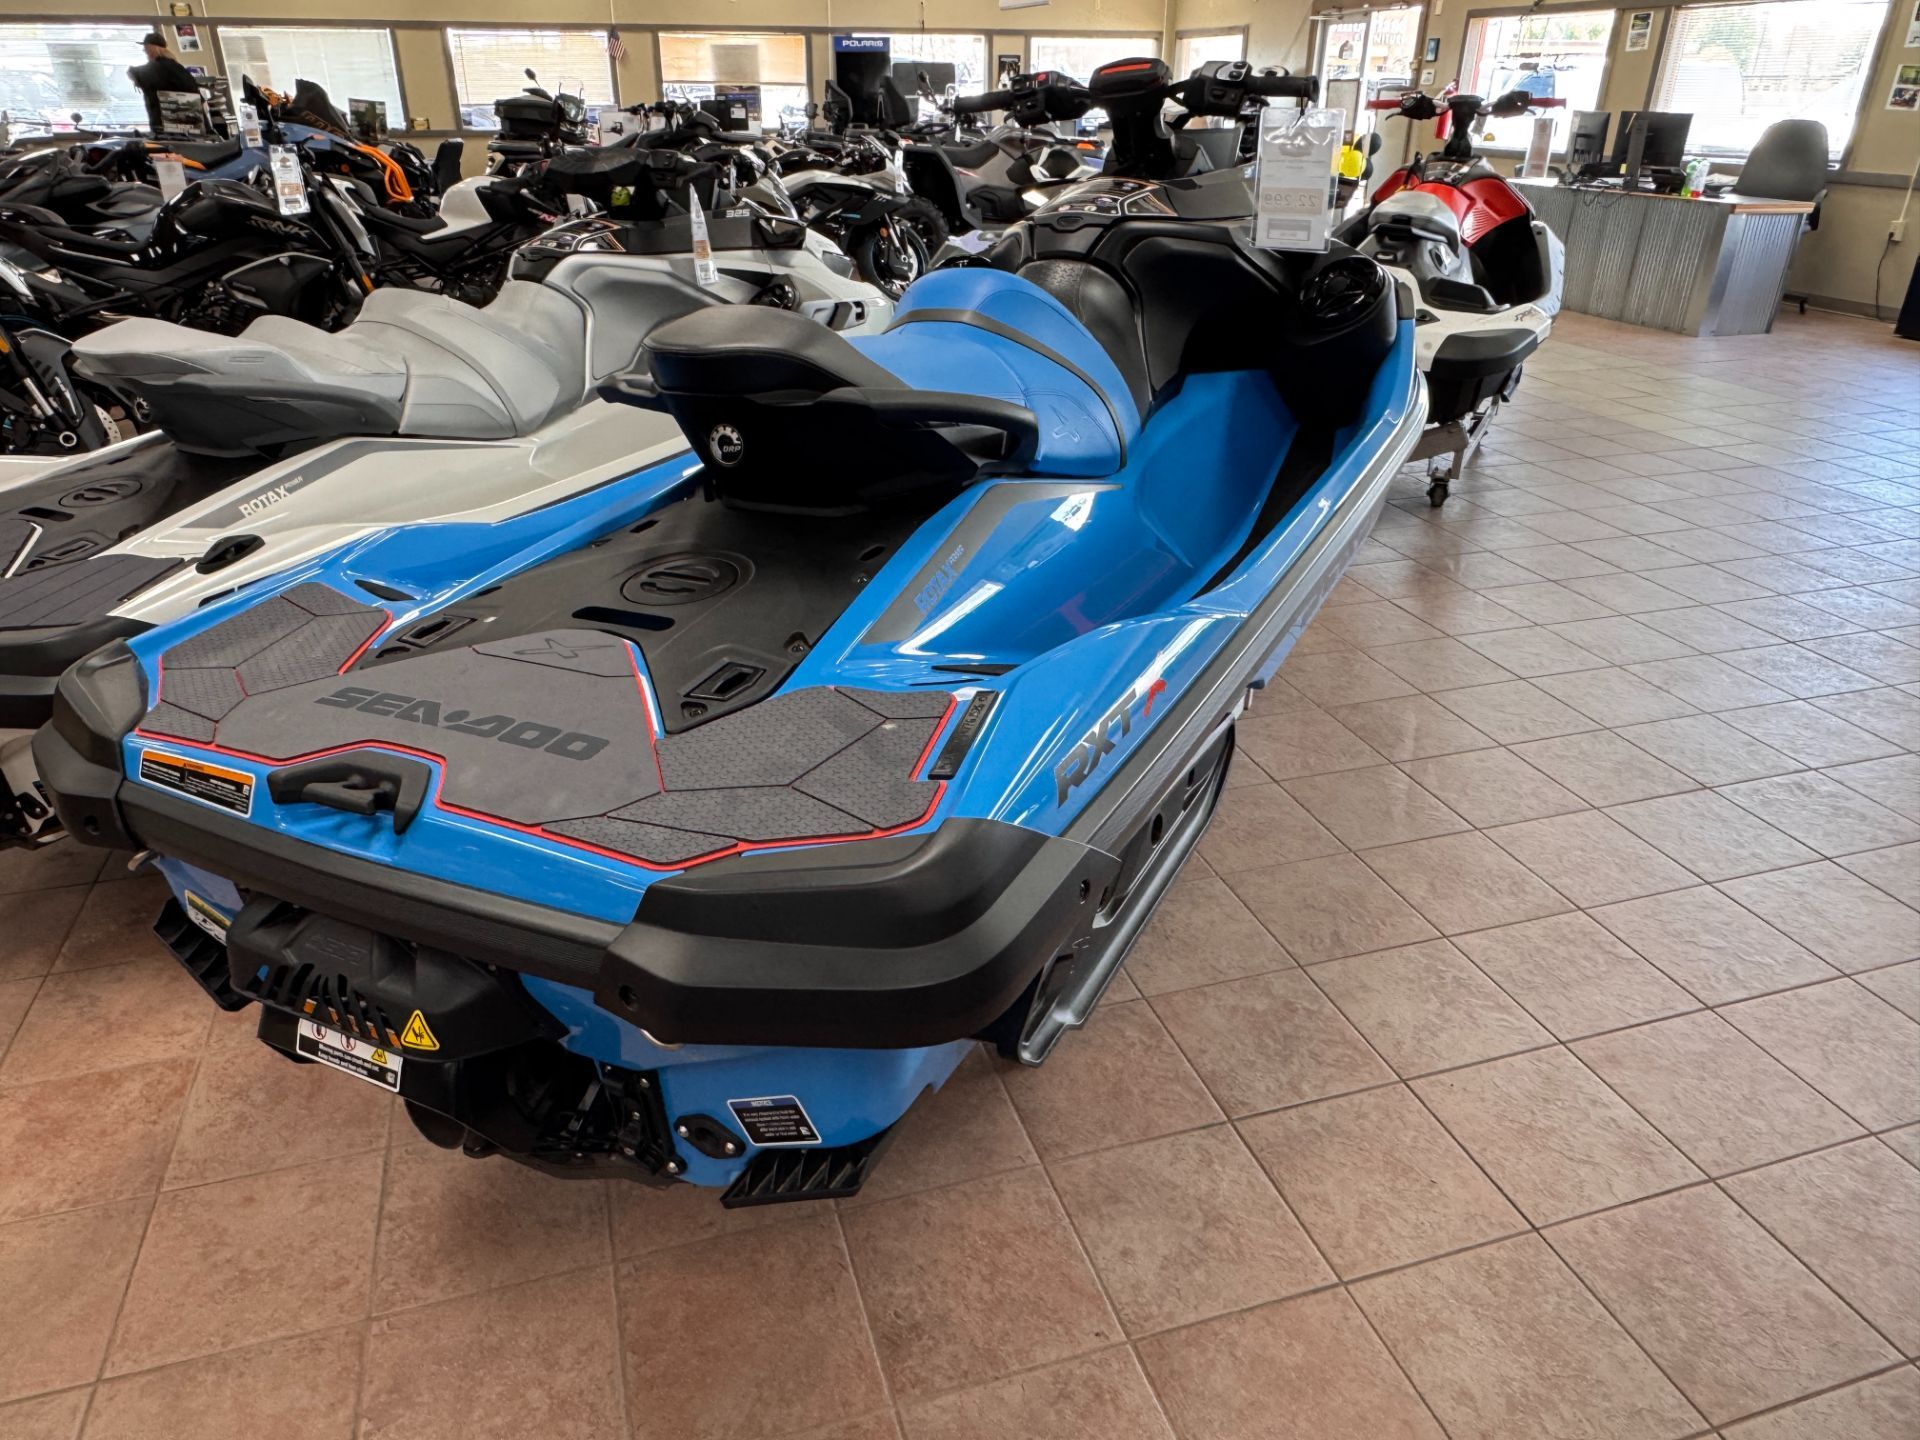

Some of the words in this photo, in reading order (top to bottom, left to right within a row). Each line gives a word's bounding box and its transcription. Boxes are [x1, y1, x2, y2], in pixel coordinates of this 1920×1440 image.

[726, 209, 752, 218] 325
[238, 485, 290, 519] ROTAX
[1053, 687, 1139, 809] RXT
